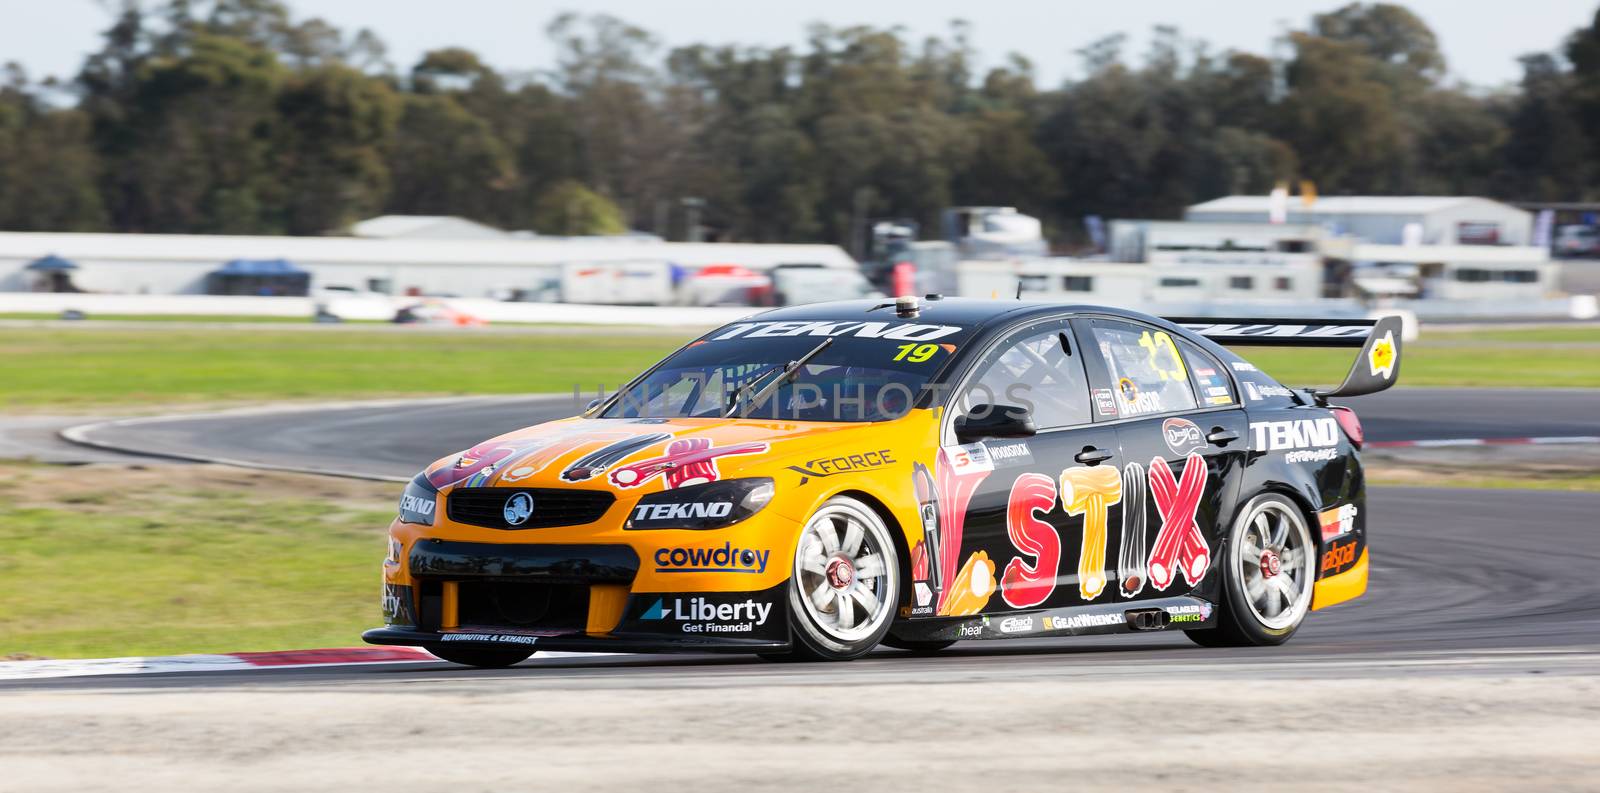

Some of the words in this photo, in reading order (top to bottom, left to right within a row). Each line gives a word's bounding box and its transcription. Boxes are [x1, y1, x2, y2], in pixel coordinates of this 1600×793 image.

[712, 321, 963, 342] TEKNO
[892, 343, 940, 363] 19
[1249, 417, 1339, 452] TEKNO
[988, 443, 1031, 461] WOODSTOCK
[400, 494, 436, 516] TEKNO
[635, 502, 733, 521] TEKNO
[1001, 452, 1211, 609] STIX
[654, 541, 770, 574] cowdroy
[675, 597, 773, 626] Liberty
[682, 623, 704, 633] Get
[705, 622, 753, 633] Financial
[441, 633, 492, 642] AUTOMOTIVE
[490, 634, 499, 642] &
[499, 634, 540, 645] EXHAUST
